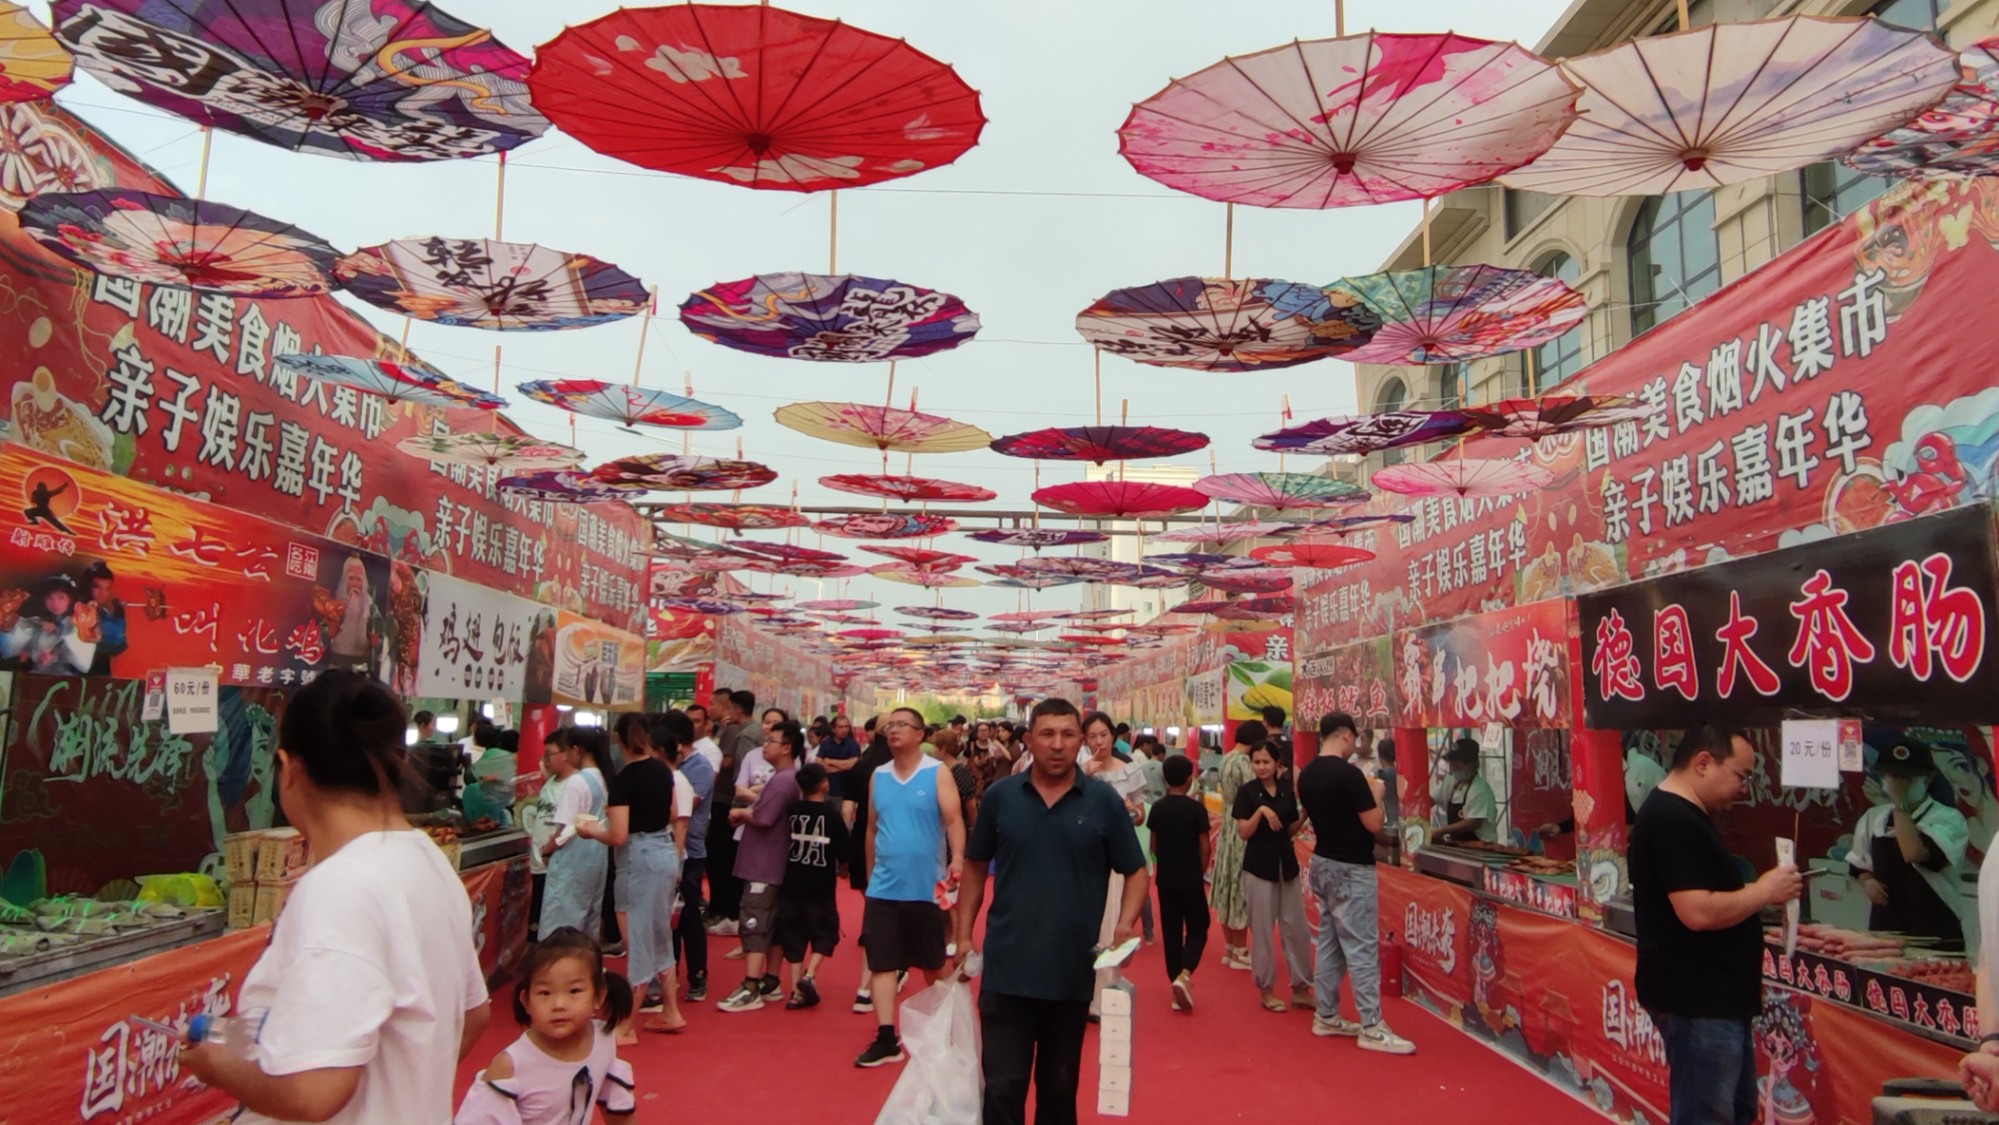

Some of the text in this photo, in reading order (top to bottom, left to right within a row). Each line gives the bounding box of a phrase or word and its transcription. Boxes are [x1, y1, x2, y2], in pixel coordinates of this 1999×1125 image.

[103, 342, 363, 514] 亲子娱乐嘉年华
[1602, 392, 1872, 543] 亲子娱乐嘉年华
[433, 494, 545, 582] 亲子娱乐嘉年华
[1406, 519, 1527, 601] 亲子娱乐嘉年华
[1592, 552, 1985, 702] 德国大香肠
